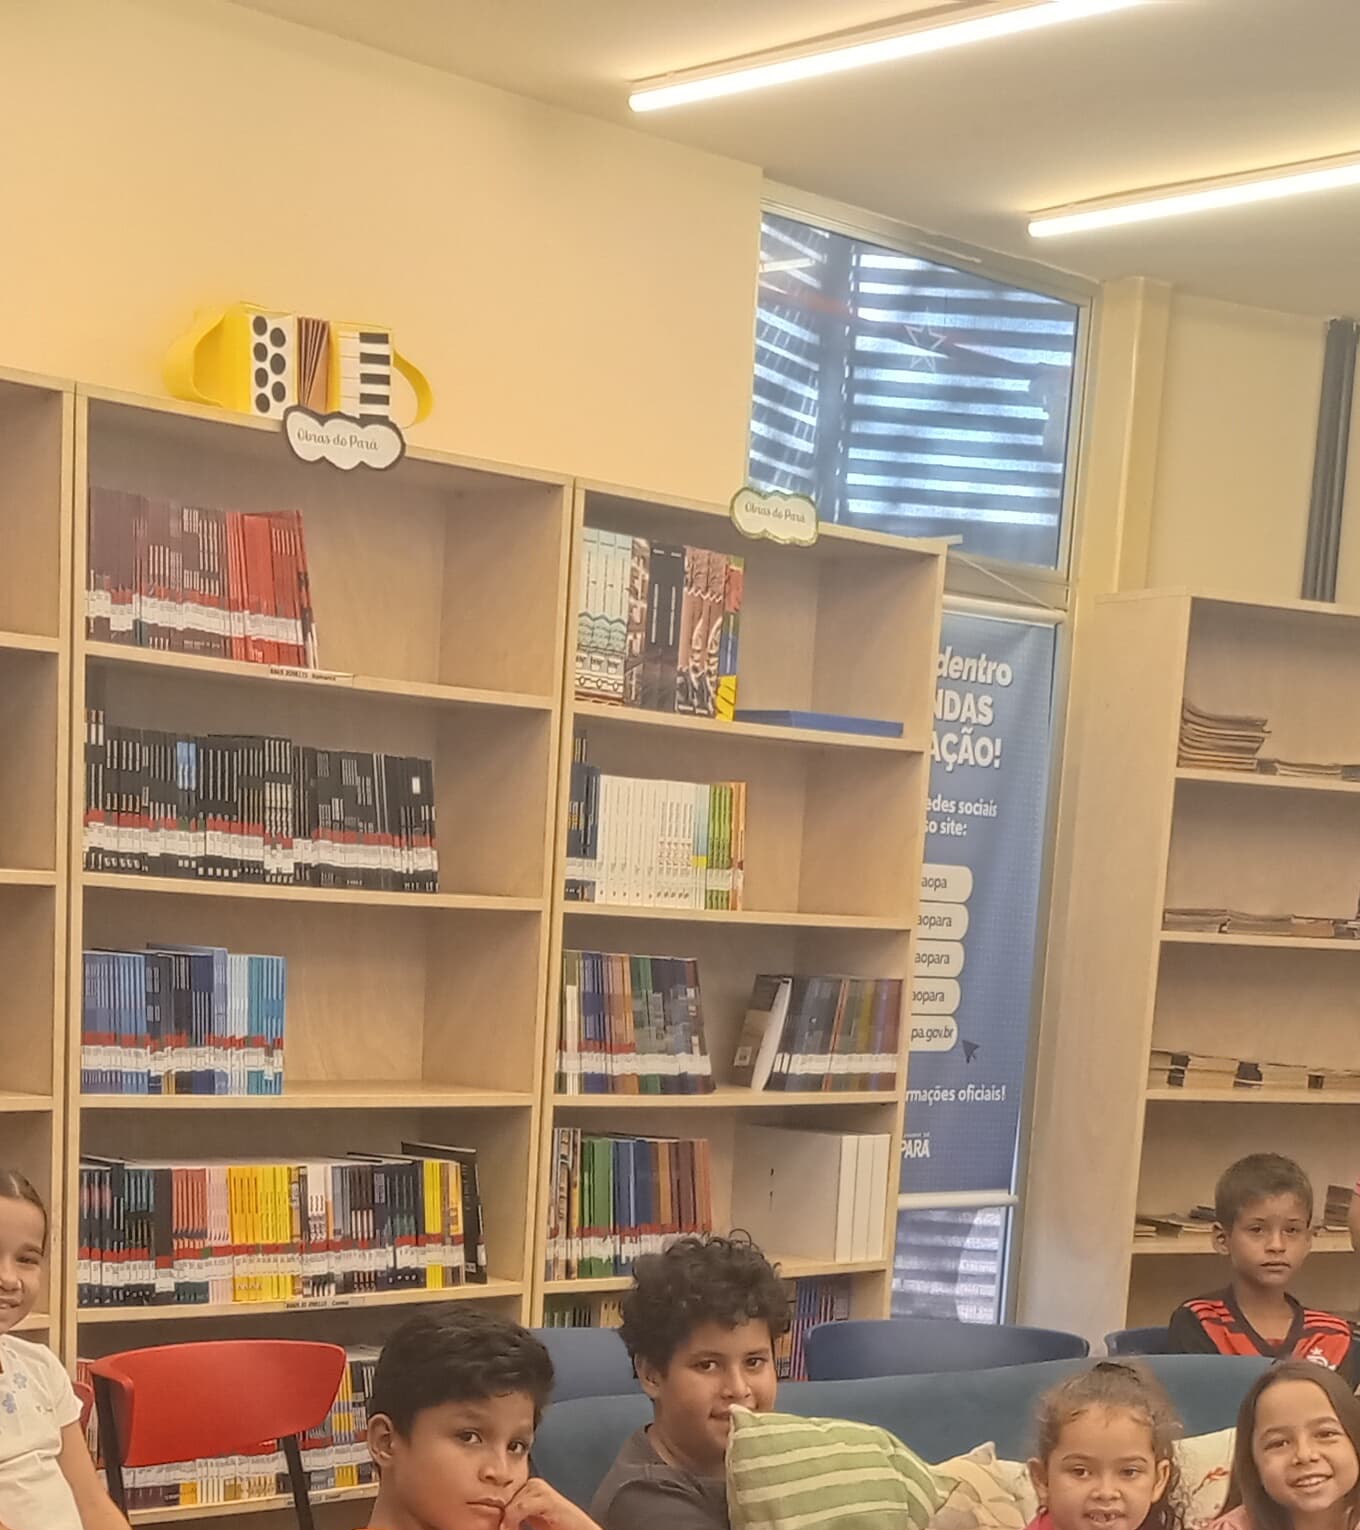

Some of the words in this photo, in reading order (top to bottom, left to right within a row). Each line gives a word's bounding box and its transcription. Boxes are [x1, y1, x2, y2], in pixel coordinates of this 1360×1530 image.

[297, 428, 330, 444] Obras
[333, 434, 347, 447] do
[936, 646, 1013, 686] dentro
[930, 728, 1002, 772] AÇÃO!
[958, 798, 998, 817] sociais
[940, 818, 968, 836] site:
[921, 877, 948, 892] aopa
[911, 1026, 955, 1042] pa.gov.br
[958, 1083, 1007, 1102] oficiais!
